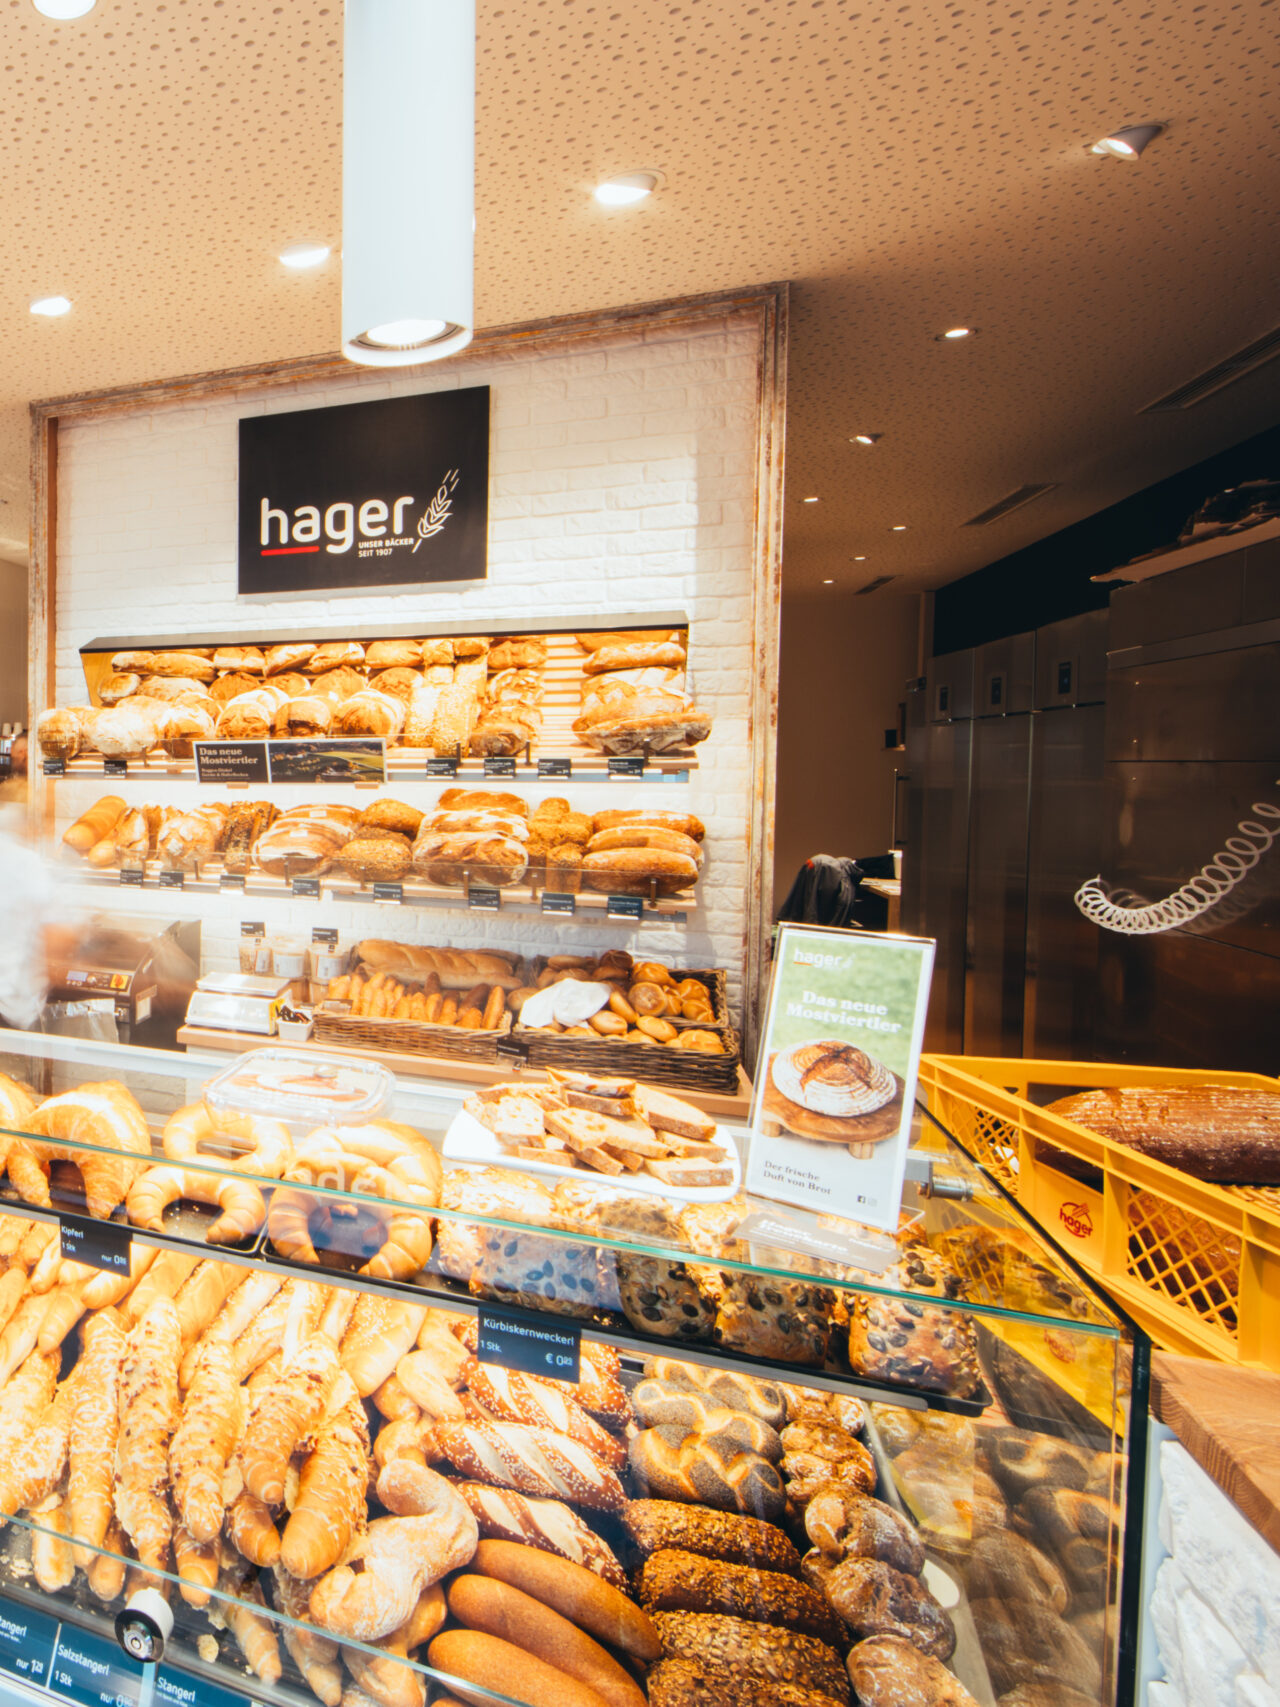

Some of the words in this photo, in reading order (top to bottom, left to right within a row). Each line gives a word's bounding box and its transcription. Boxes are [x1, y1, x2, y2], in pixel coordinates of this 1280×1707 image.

[261, 496, 415, 554] hager
[358, 540, 383, 549] UNSER
[385, 537, 414, 547] BÄCKER
[358, 549, 374, 558] SEIT
[376, 548, 393, 556] 1907
[200, 747, 218, 756] Das
[219, 748, 242, 756] neue
[200, 755, 258, 765] Mostviertler
[793, 948, 842, 969] hager
[802, 990, 837, 1008] Das
[841, 999, 888, 1016] neue
[786, 1002, 903, 1034] Mostviertler
[764, 1160, 783, 1171] Der
[785, 1166, 820, 1181] frische
[763, 1170, 785, 1182] Duft
[787, 1177, 805, 1188] von
[808, 1182, 832, 1195] Brot
[1059, 1208, 1093, 1236] hager
[61, 1225, 84, 1239] Kipferl
[483, 1317, 574, 1346] Kürbiskernweckerl
[486, 1341, 502, 1352] Stk.
[545, 1352, 554, 1364] €
[15, 1658, 29, 1670] nur
[57, 1643, 110, 1676] Salzstangerl
[59, 1672, 73, 1687] Stk
[157, 1676, 197, 1702] Stangerl
[99, 1692, 114, 1705] nur
